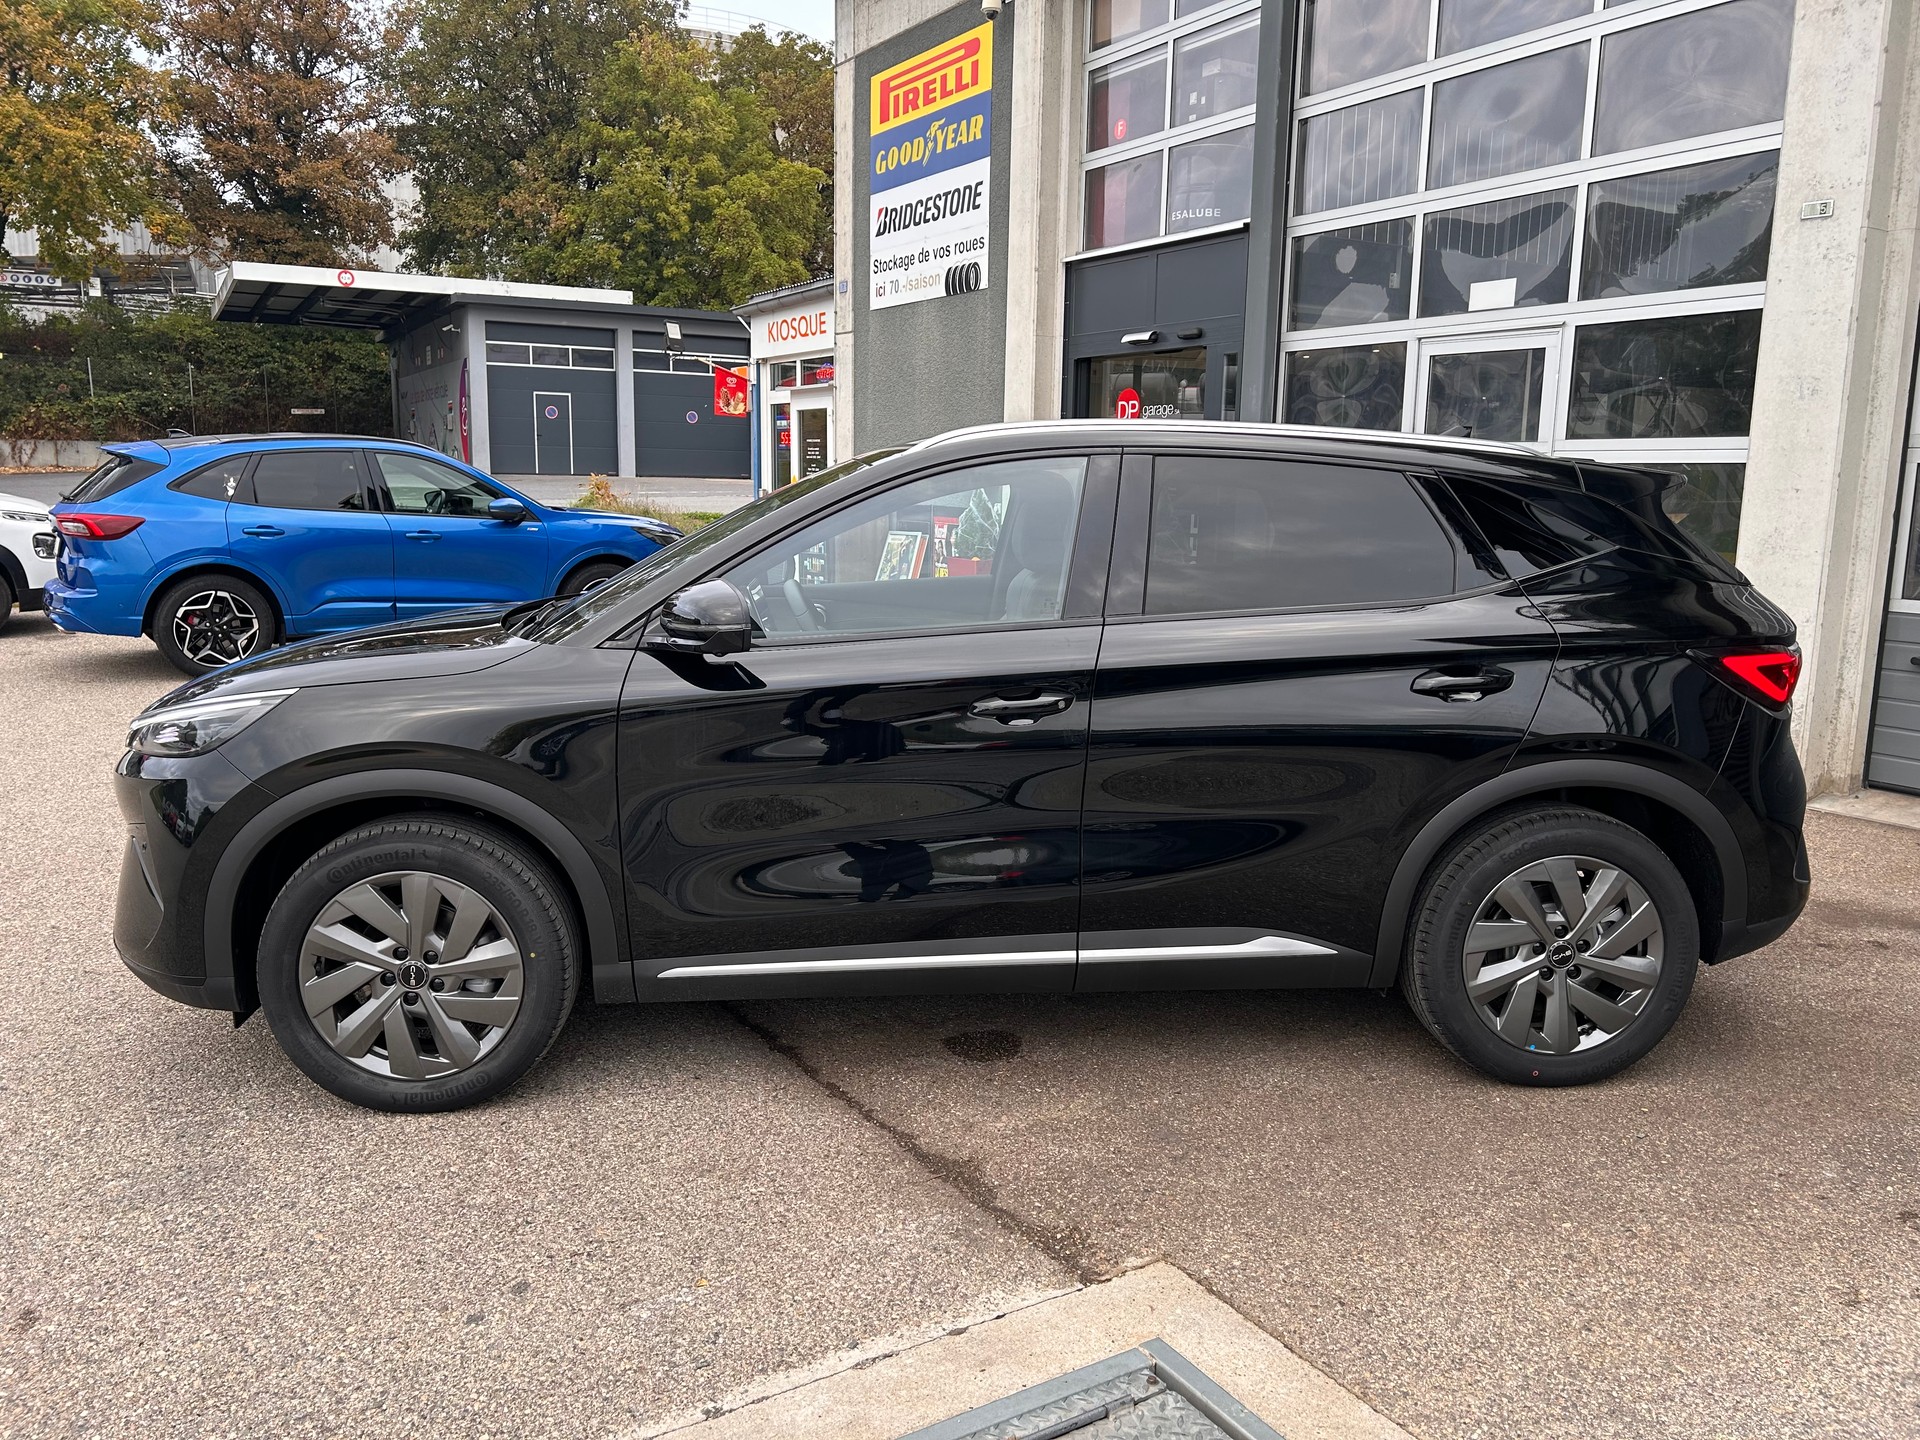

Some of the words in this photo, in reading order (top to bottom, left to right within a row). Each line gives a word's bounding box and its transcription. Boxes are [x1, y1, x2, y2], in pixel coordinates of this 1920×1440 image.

[879, 36, 981, 124] PIRELLI
[875, 180, 984, 237] BRIDGESTONE
[873, 253, 916, 275] Stockage
[917, 246, 930, 264] de
[932, 244, 951, 260] vos
[954, 235, 986, 256] roues
[875, 280, 886, 298] ici
[767, 312, 827, 343] KIOSQUE
[1117, 401, 1139, 419] DP
[1142, 404, 1174, 419] garage
